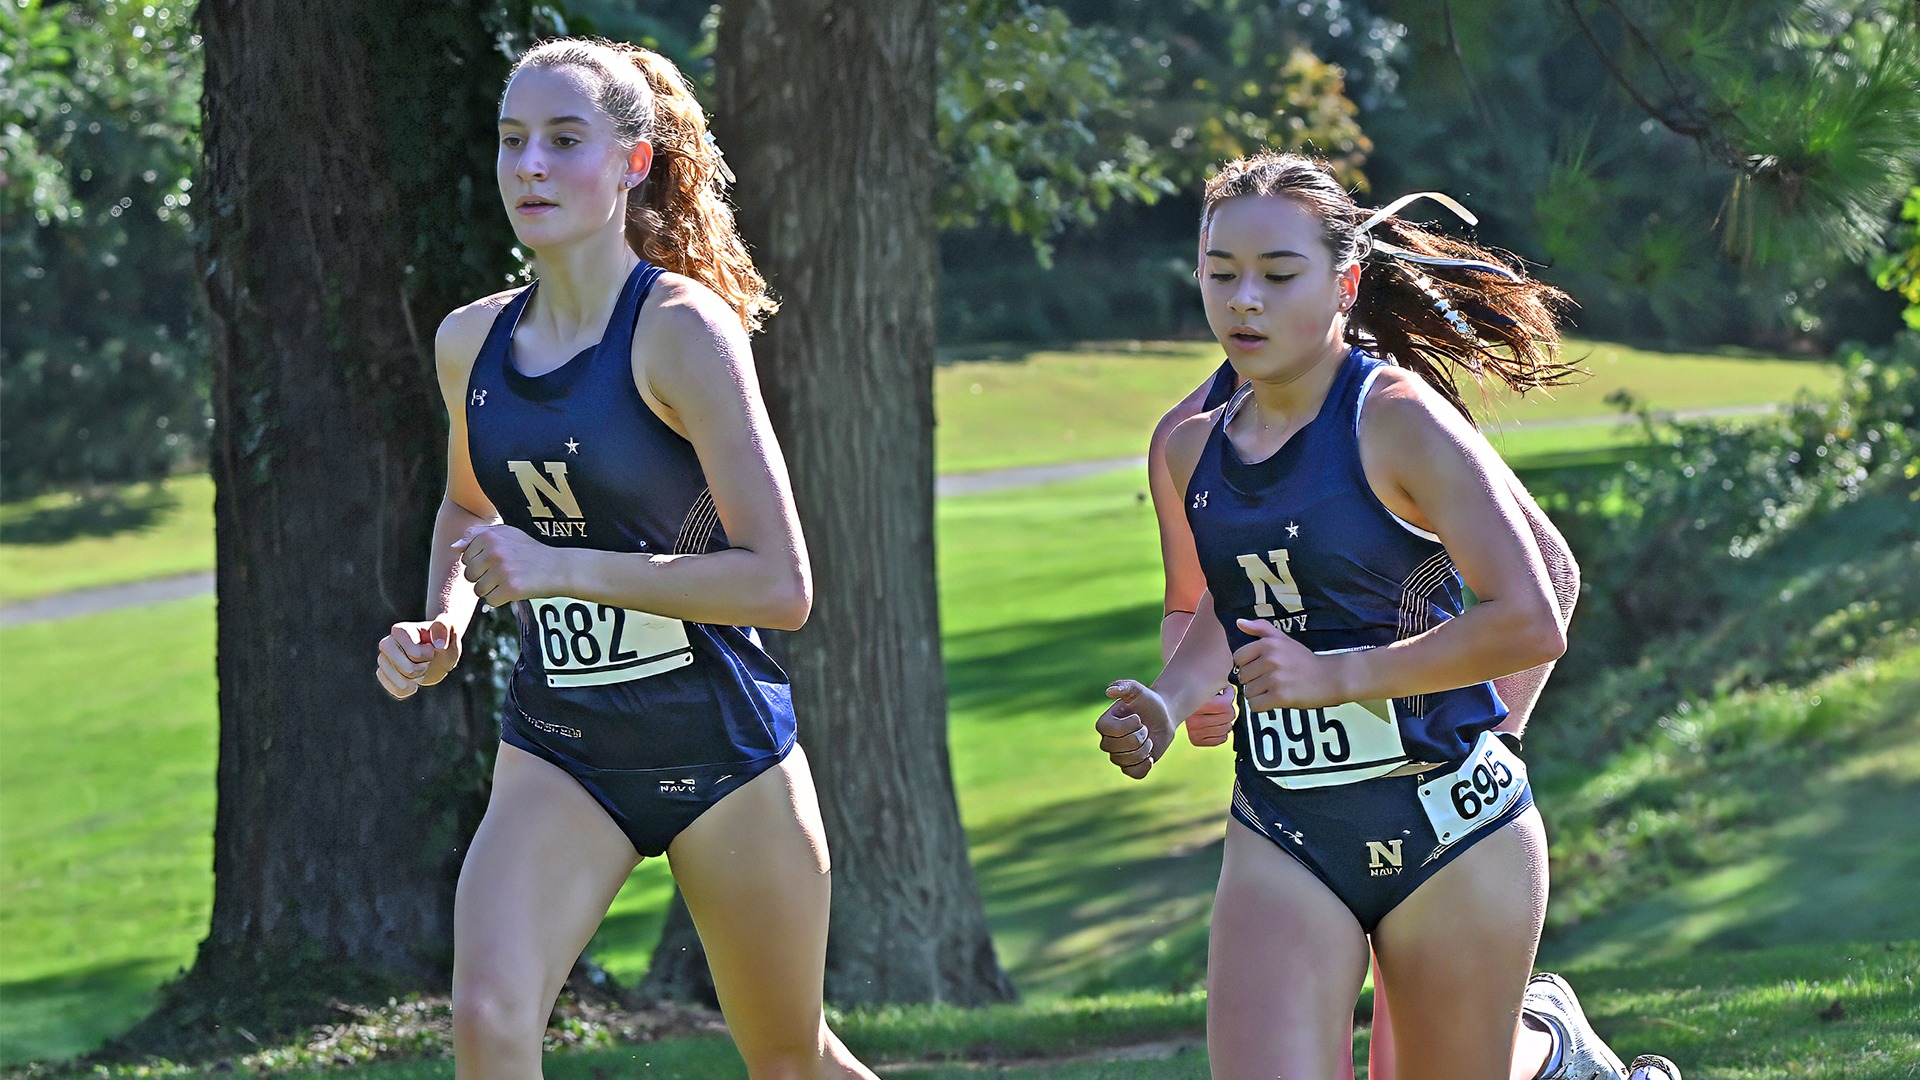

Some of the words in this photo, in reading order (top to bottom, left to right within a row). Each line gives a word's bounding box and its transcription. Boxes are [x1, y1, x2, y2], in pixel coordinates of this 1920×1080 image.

[507, 460, 584, 518] N
[533, 520, 588, 537] NAVY
[1236, 548, 1305, 617] N
[538, 602, 639, 668] 682
[1252, 704, 1352, 769] 695
[1450, 750, 1513, 820] 695
[1365, 839, 1403, 868] N
[1370, 867, 1403, 877] NAVY
